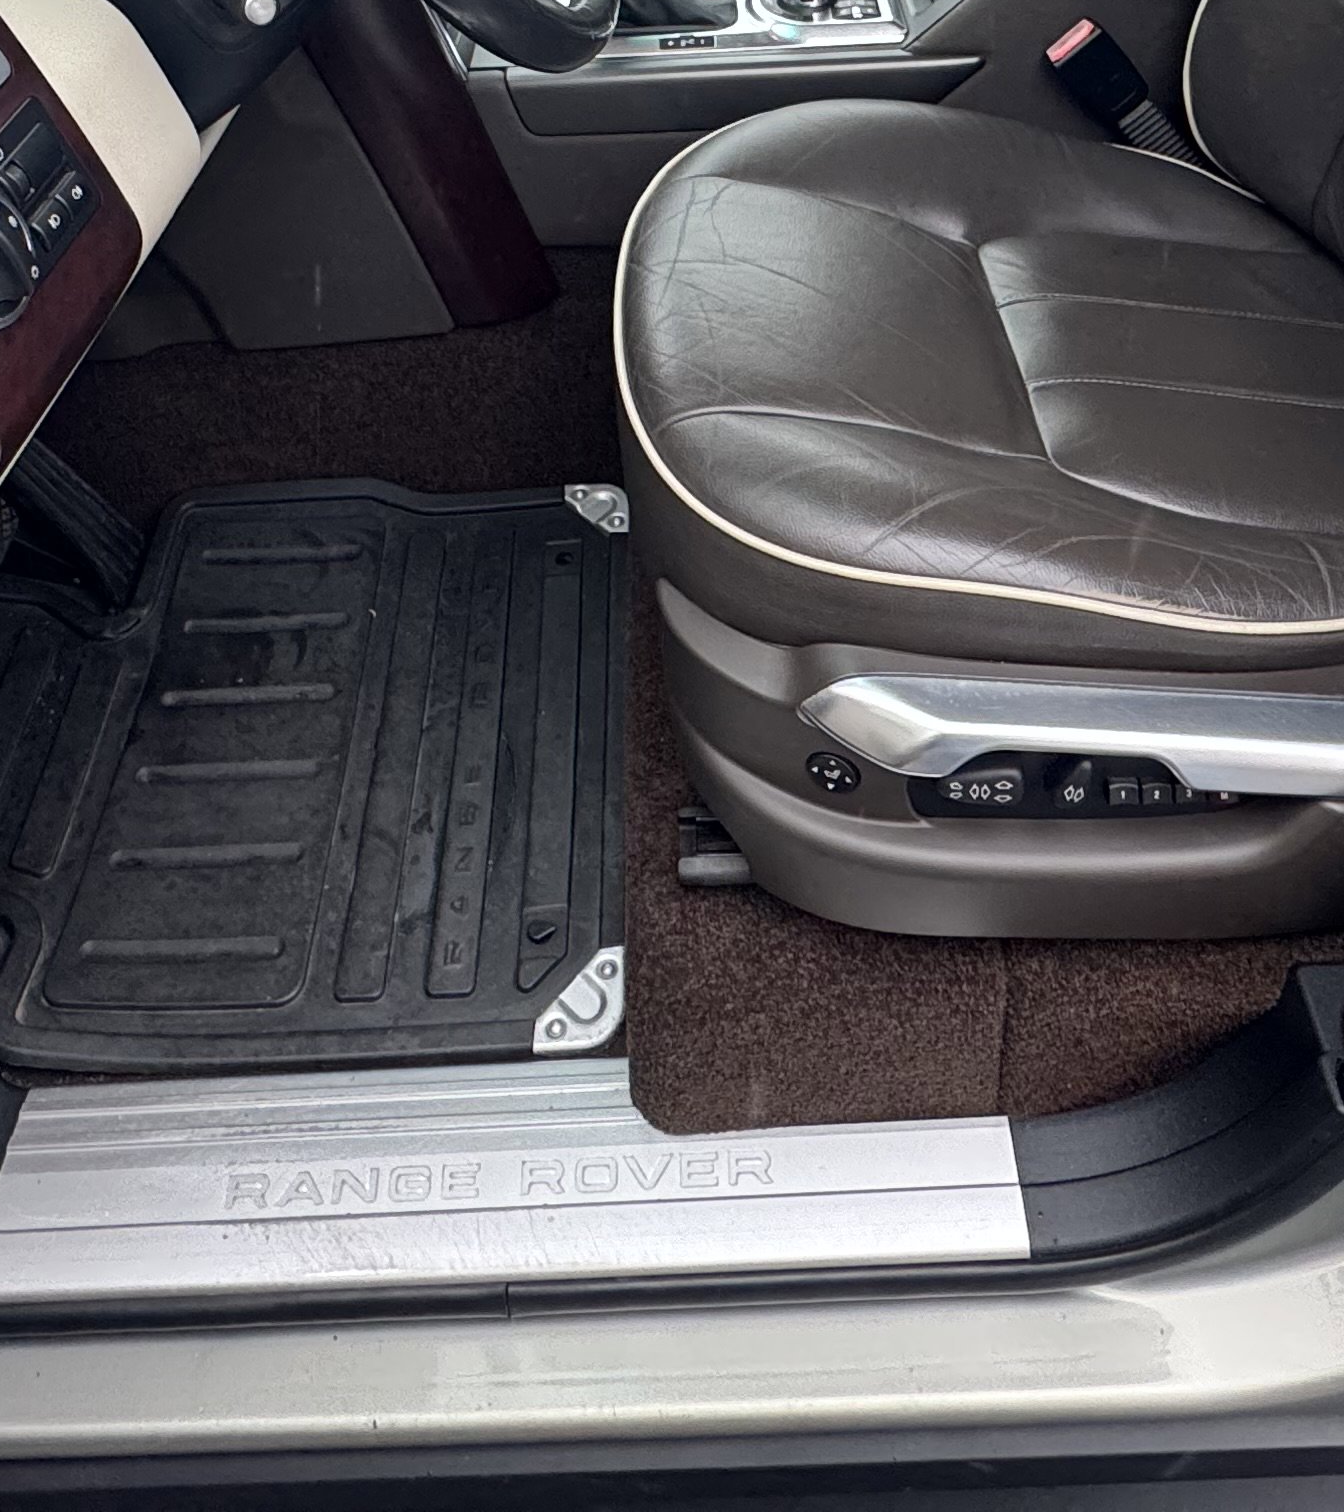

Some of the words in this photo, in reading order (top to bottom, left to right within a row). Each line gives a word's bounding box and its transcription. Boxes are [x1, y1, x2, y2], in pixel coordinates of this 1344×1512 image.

[1120, 790, 1126, 800] 1
[1153, 790, 1160, 800] 2
[1186, 789, 1192, 798] 3
[224, 1162, 482, 1210] RANGE
[520, 1149, 774, 1196] ROVER
